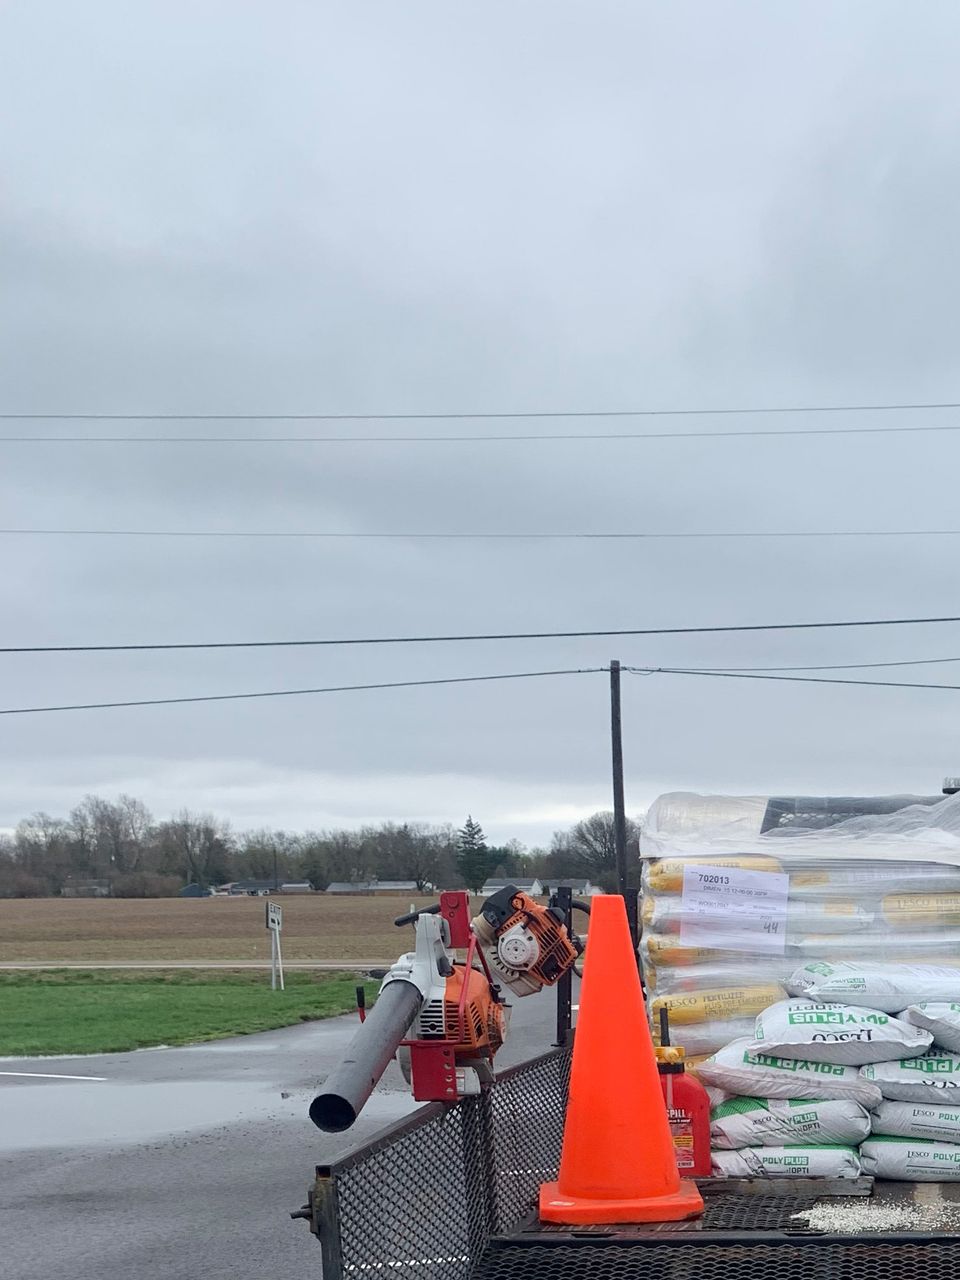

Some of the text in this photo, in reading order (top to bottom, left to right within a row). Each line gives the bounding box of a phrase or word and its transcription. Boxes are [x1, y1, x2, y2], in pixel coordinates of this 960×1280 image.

[698, 874, 730, 885] 702013
[763, 922, 779, 934] 44
[667, 997, 697, 1011] LESCO
[793, 1012, 841, 1024] PLUS
[799, 1061, 845, 1076] POLY
[794, 1112, 817, 1124] PLUS
[912, 1109, 935, 1117] LESCO
[938, 1113, 959, 1121] POLY
[803, 1122, 820, 1132] OPTI
[762, 1157, 808, 1165] POLY PLUS
[908, 1150, 930, 1159] LESCO
[933, 1153, 954, 1161] POLY
